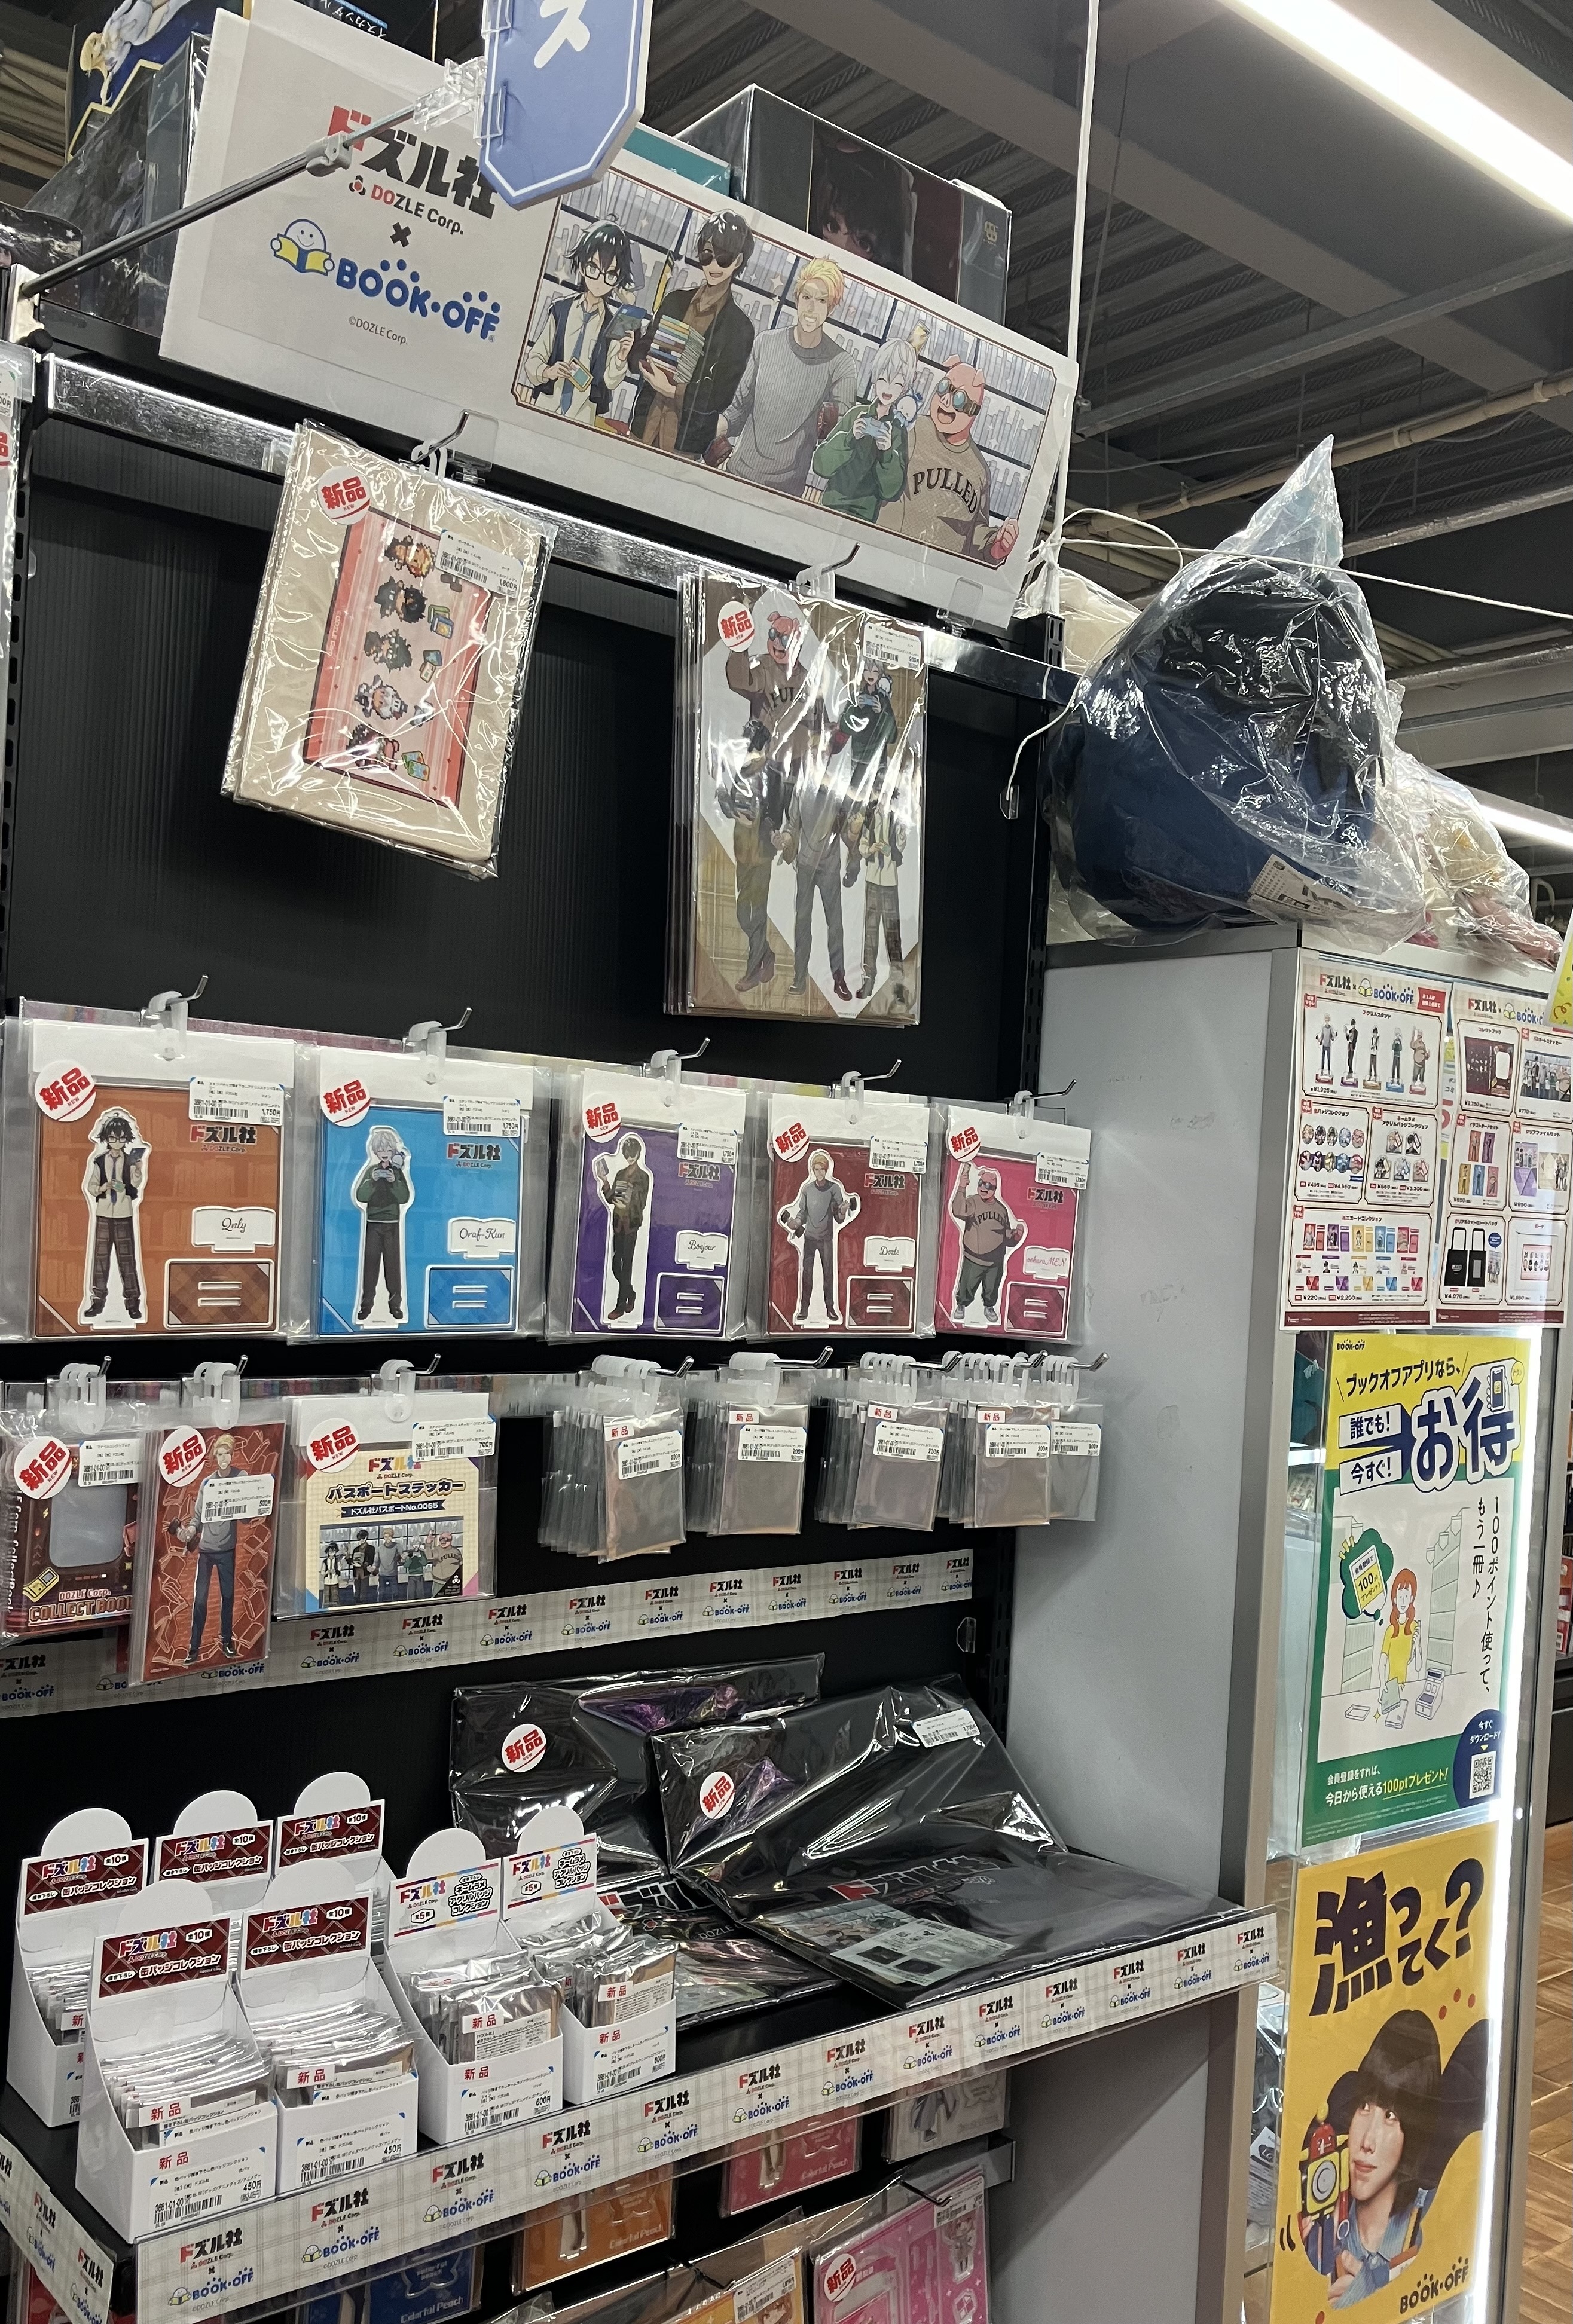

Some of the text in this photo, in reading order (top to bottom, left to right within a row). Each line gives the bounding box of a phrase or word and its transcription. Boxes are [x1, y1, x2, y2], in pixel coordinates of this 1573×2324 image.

[371, 184, 463, 235] DOZLE Corp.
[386, 331, 408, 345] Corp.
[321, 476, 367, 510] 新品
[912, 471, 979, 515] PULLED
[720, 610, 753, 640] 新品
[1320, 973, 1351, 990] ドズル社
[1468, 998, 1496, 1013] ドズル社
[39, 1067, 91, 1111] 新品
[323, 1080, 367, 1114] 新品
[67, 1096, 80, 1108] NEW
[585, 1102, 619, 1129] 新品
[190, 1125, 256, 1143] ドズル社
[775, 1123, 807, 1154] 新品
[951, 1126, 980, 1154] 新品
[447, 1143, 501, 1161] ドズル社
[679, 1163, 720, 1181] ドズル社
[864, 1173, 905, 1189] ドズル社
[1027, 1187, 1064, 1204] ドズル社
[879, 1246, 900, 1256] Dozle
[1346, 1357, 1461, 1398] ブックオフアプリなら、
[736, 1413, 753, 1423] 新品
[874, 1408, 892, 1418] 新品
[983, 1412, 1000, 1421] 新品
[1350, 1411, 1391, 1439] 誰でも!
[1417, 1377, 1516, 1481] お得
[310, 1426, 356, 1461] 新品
[19, 1440, 66, 1491] 新品
[163, 1435, 204, 1476] 新品
[332, 1451, 343, 1460] NEW
[47, 1470, 59, 1483] NEW
[1351, 1456, 1392, 1485] 今すぐ!
[327, 1479, 465, 1502] パスポートステッカー
[350, 1503, 438, 1516] ドズル社パスポートNo.0065
[59, 1588, 112, 1601] DOZLE Corp.
[710, 1579, 743, 1592] ドズル社
[30, 1600, 96, 1623] COLLECT
[488, 1604, 527, 1620] ドズル社
[310, 1624, 355, 1641] ドズル社
[1478, 1720, 1493, 1730] 今すぐ
[505, 1729, 543, 1764] 新品
[523, 1753, 533, 1761] NEW
[1327, 1764, 1380, 1786] 会員登録をすれば、
[702, 1776, 732, 1812] 新品
[294, 1814, 340, 1836] ドズル社
[175, 1835, 225, 1857] ドズル社
[310, 1833, 375, 1852] 缶バッジコレクション
[42, 1855, 96, 1880] ドズル社
[192, 1856, 263, 1875] 缶バッジコレクション
[513, 1854, 551, 1875] ドズル社
[61, 1876, 136, 1898] 缶バッジコレクション
[400, 1880, 445, 1904] ドズル社
[262, 1908, 318, 1933] ドズル社
[118, 1931, 178, 1958] ドズル社
[282, 1931, 361, 1952] 缶バッジコレクション
[1237, 1926, 1264, 1944] ドズル社
[139, 1954, 221, 1979] 缶バッジコレクション
[1113, 1959, 1144, 1979] ドズル社
[979, 1995, 1013, 2017] ドズル社
[472, 2014, 496, 2029] 新品
[909, 2016, 945, 2038] ドズル社
[600, 2029, 621, 2044] 新品
[298, 2068, 325, 2084] 新品
[464, 2066, 488, 2080] 新品
[739, 2063, 781, 2089] ドズル社
[536, 2096, 551, 2106] 600円
[151, 2103, 181, 2121] 新品
[542, 2120, 591, 2149] ドズル社
[384, 2143, 402, 2154] 450円
[159, 2151, 188, 2170] 新品
[432, 2152, 484, 2183] ドズル社
[243, 2179, 262, 2191] 450円
[311, 2188, 369, 2221] ドズル社
[180, 2227, 243, 2263] ドズル社
[198, 2252, 234, 2269] DOZLE Corp.
[826, 2257, 855, 2294] 新品
